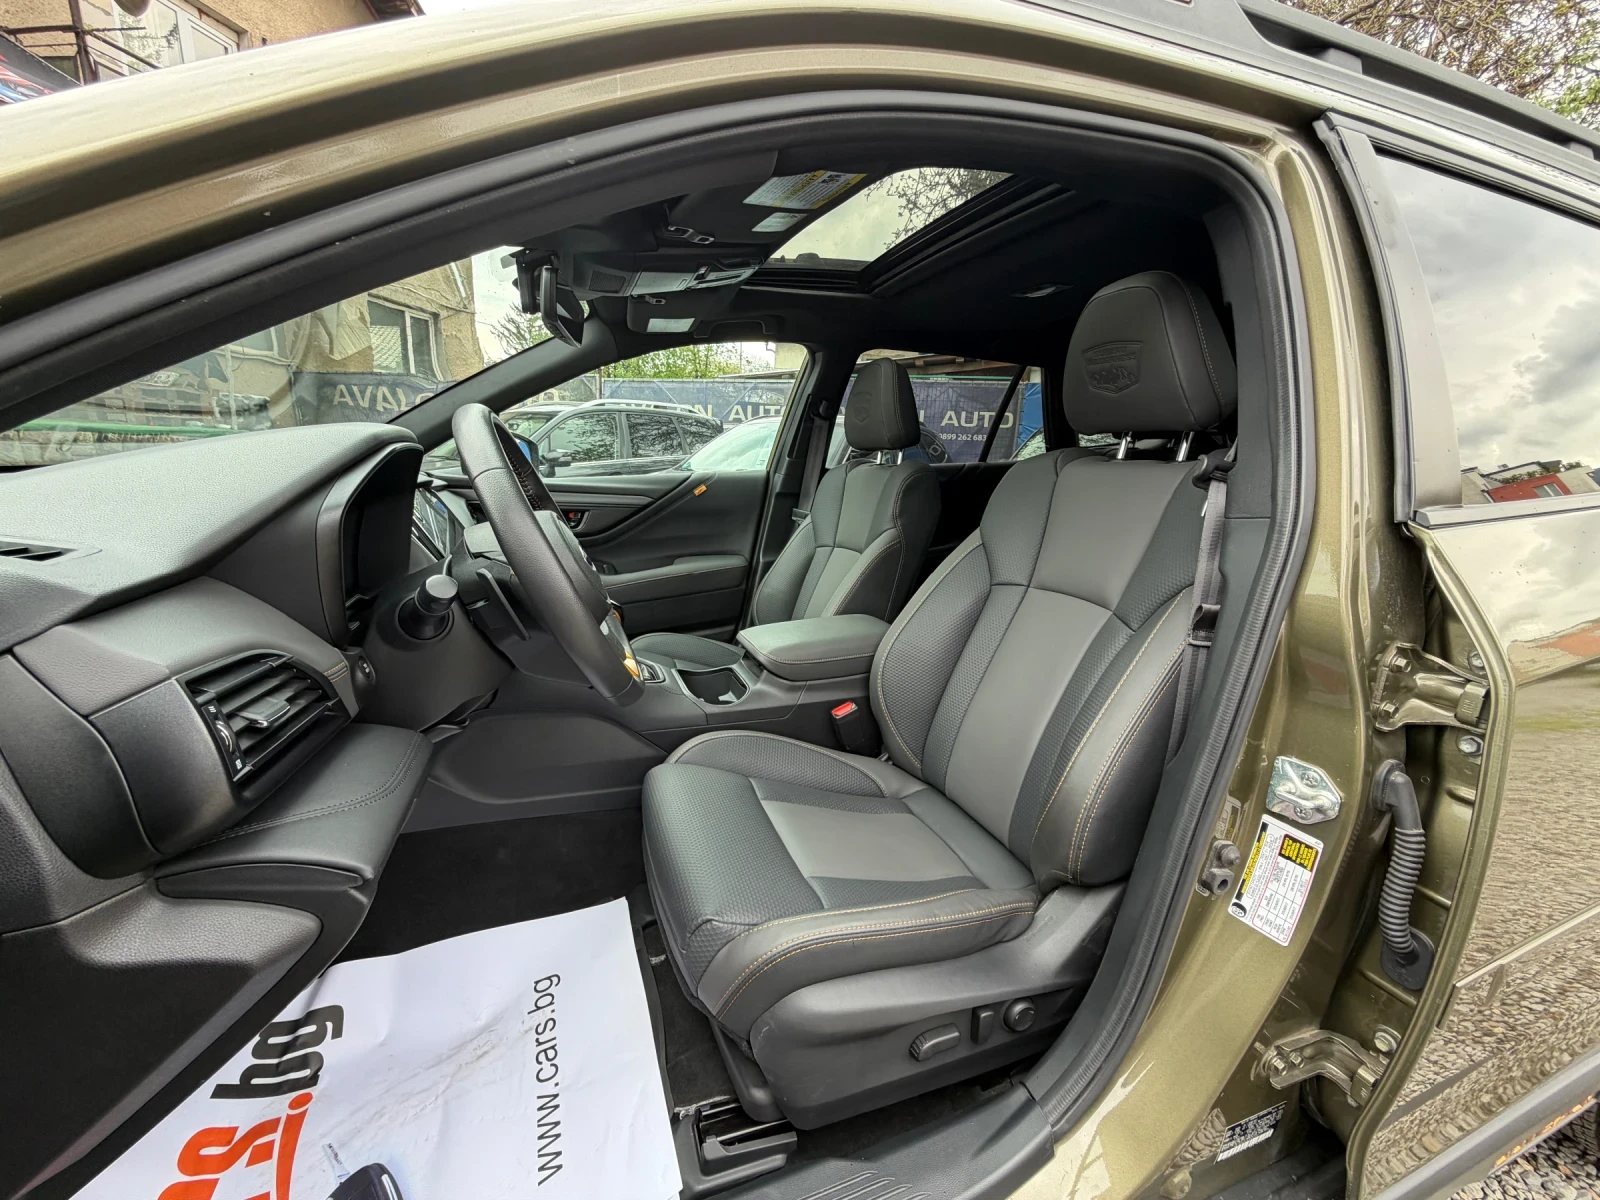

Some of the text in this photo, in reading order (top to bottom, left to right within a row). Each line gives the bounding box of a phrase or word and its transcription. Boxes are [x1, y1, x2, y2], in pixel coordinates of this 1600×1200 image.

[940, 410, 1014, 429] AUTO
[957, 433, 972, 441] 262
[527, 973, 564, 1187] www.cars.bg
